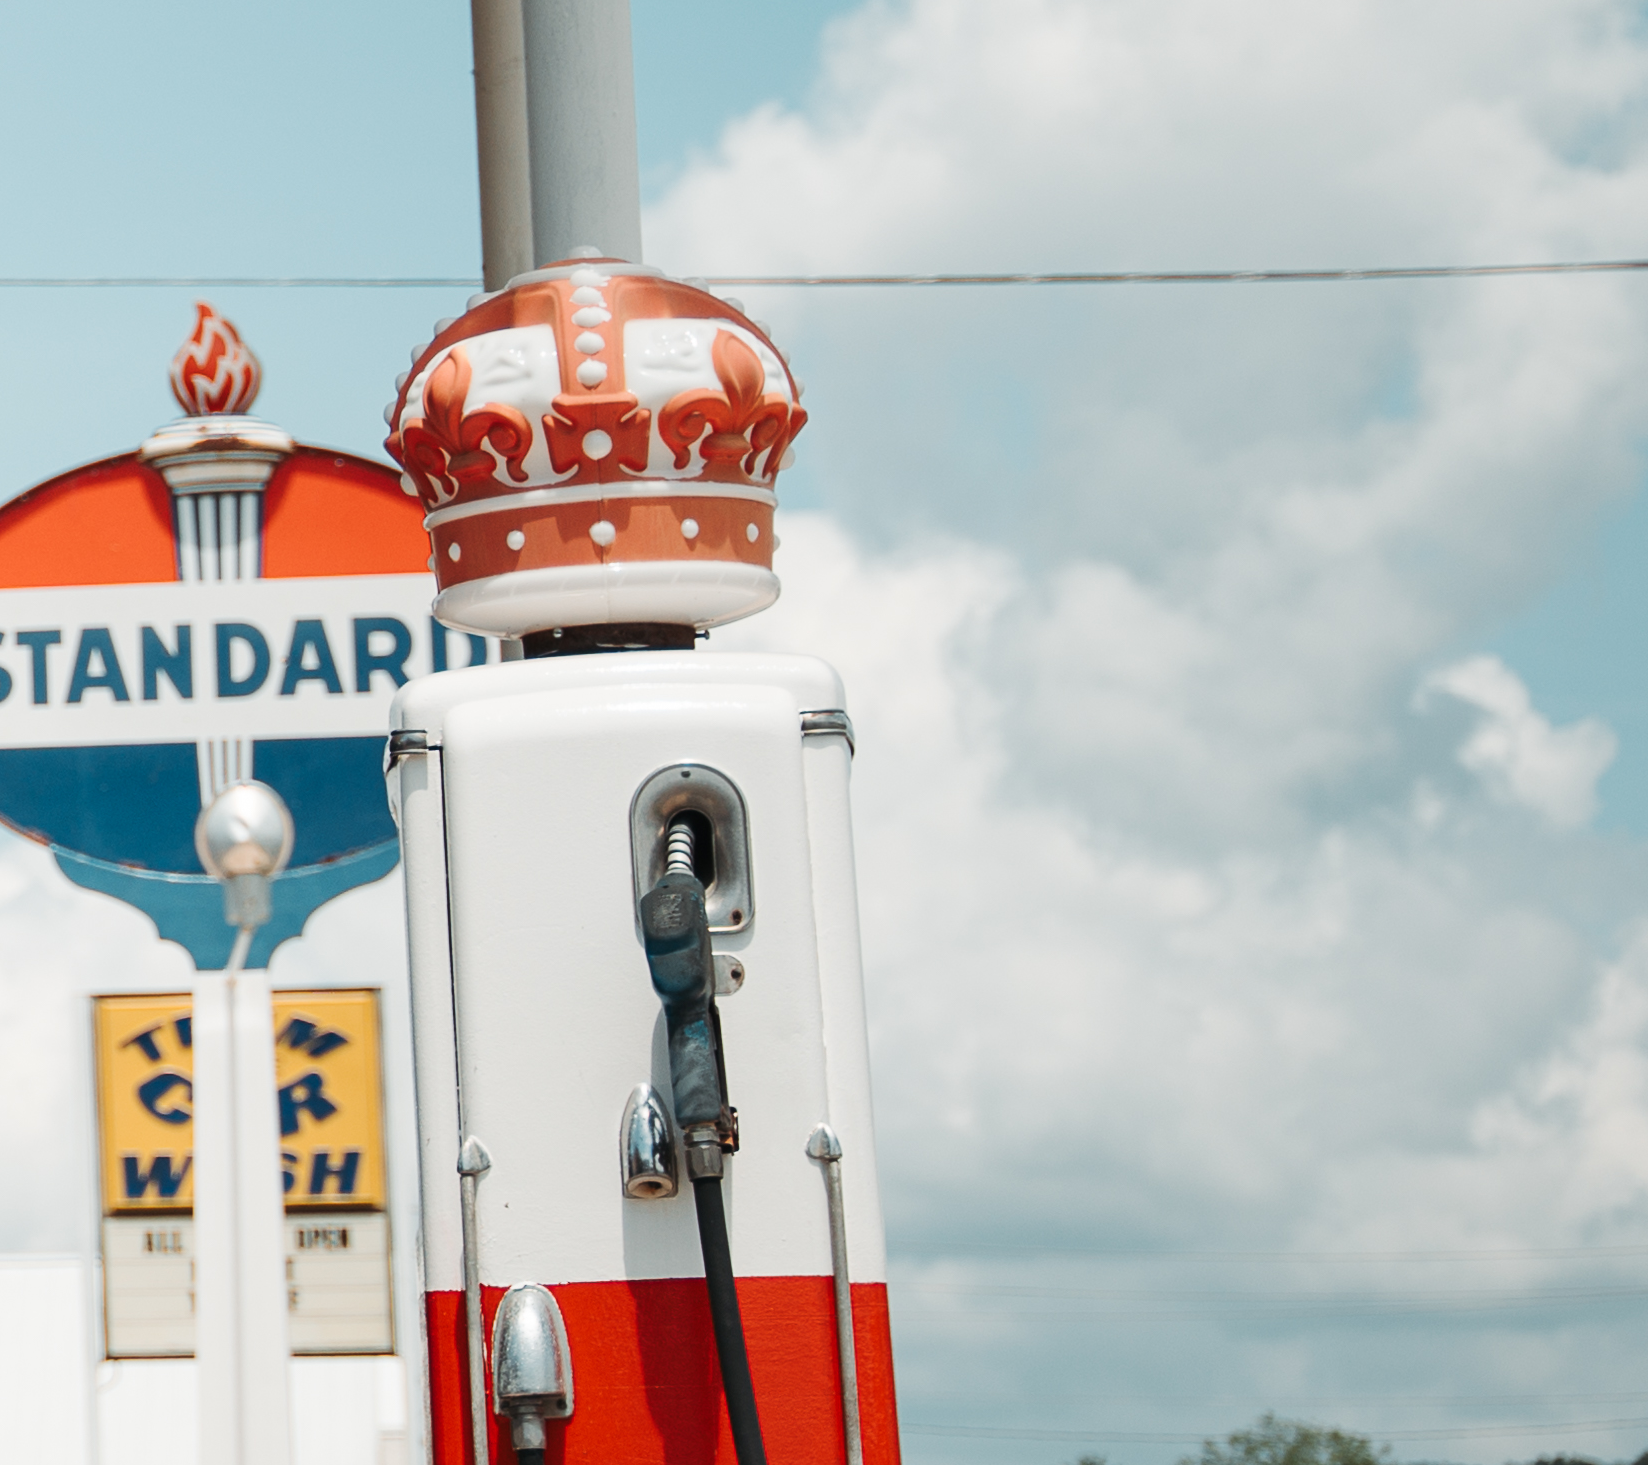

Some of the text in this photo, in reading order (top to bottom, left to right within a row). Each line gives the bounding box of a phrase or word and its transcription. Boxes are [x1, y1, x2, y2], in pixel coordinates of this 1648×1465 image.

[120, 1015, 349, 1061] TM
[137, 1071, 338, 1137] CR
[121, 1151, 361, 1198] WH
